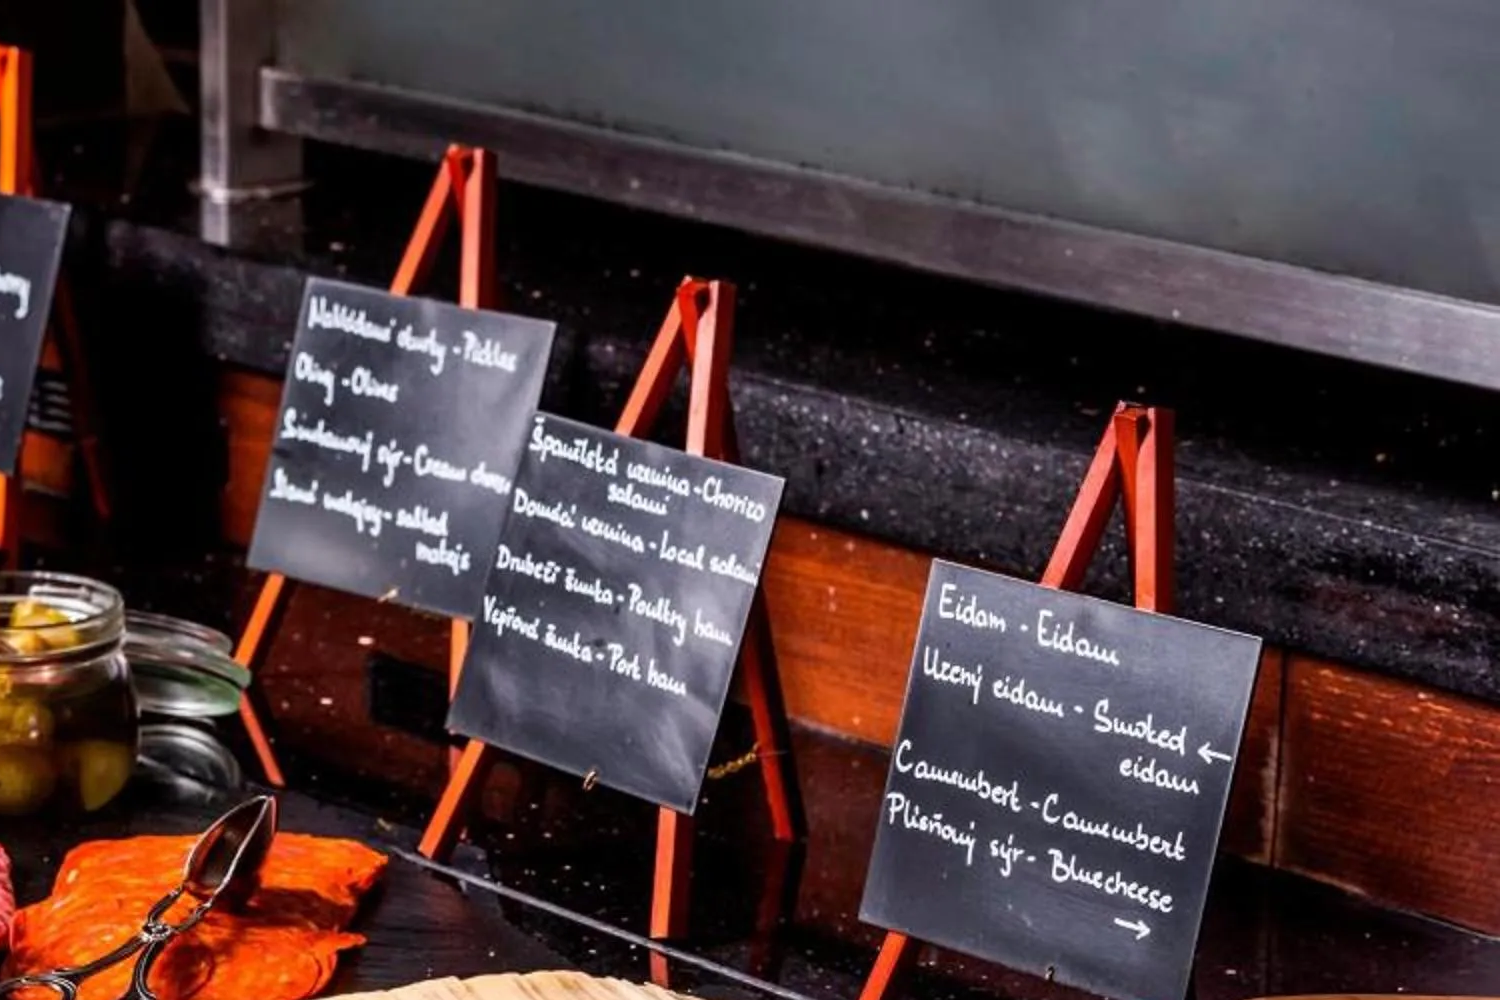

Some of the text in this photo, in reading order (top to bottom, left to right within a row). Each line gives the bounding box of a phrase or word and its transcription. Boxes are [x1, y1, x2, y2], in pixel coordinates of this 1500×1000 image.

[627, 582, 687, 647] Poultry
[693, 607, 734, 647] ham
[939, 583, 1007, 632] Eidam
[1036, 610, 1120, 666] Eidam
[647, 658, 688, 696] ham
[992, 675, 1064, 717] eidam
[1094, 699, 1187, 756] Smoked
[894, 740, 1022, 813] Camembert
[1041, 793, 1187, 861] Camembert
[1119, 755, 1199, 795] eidam
